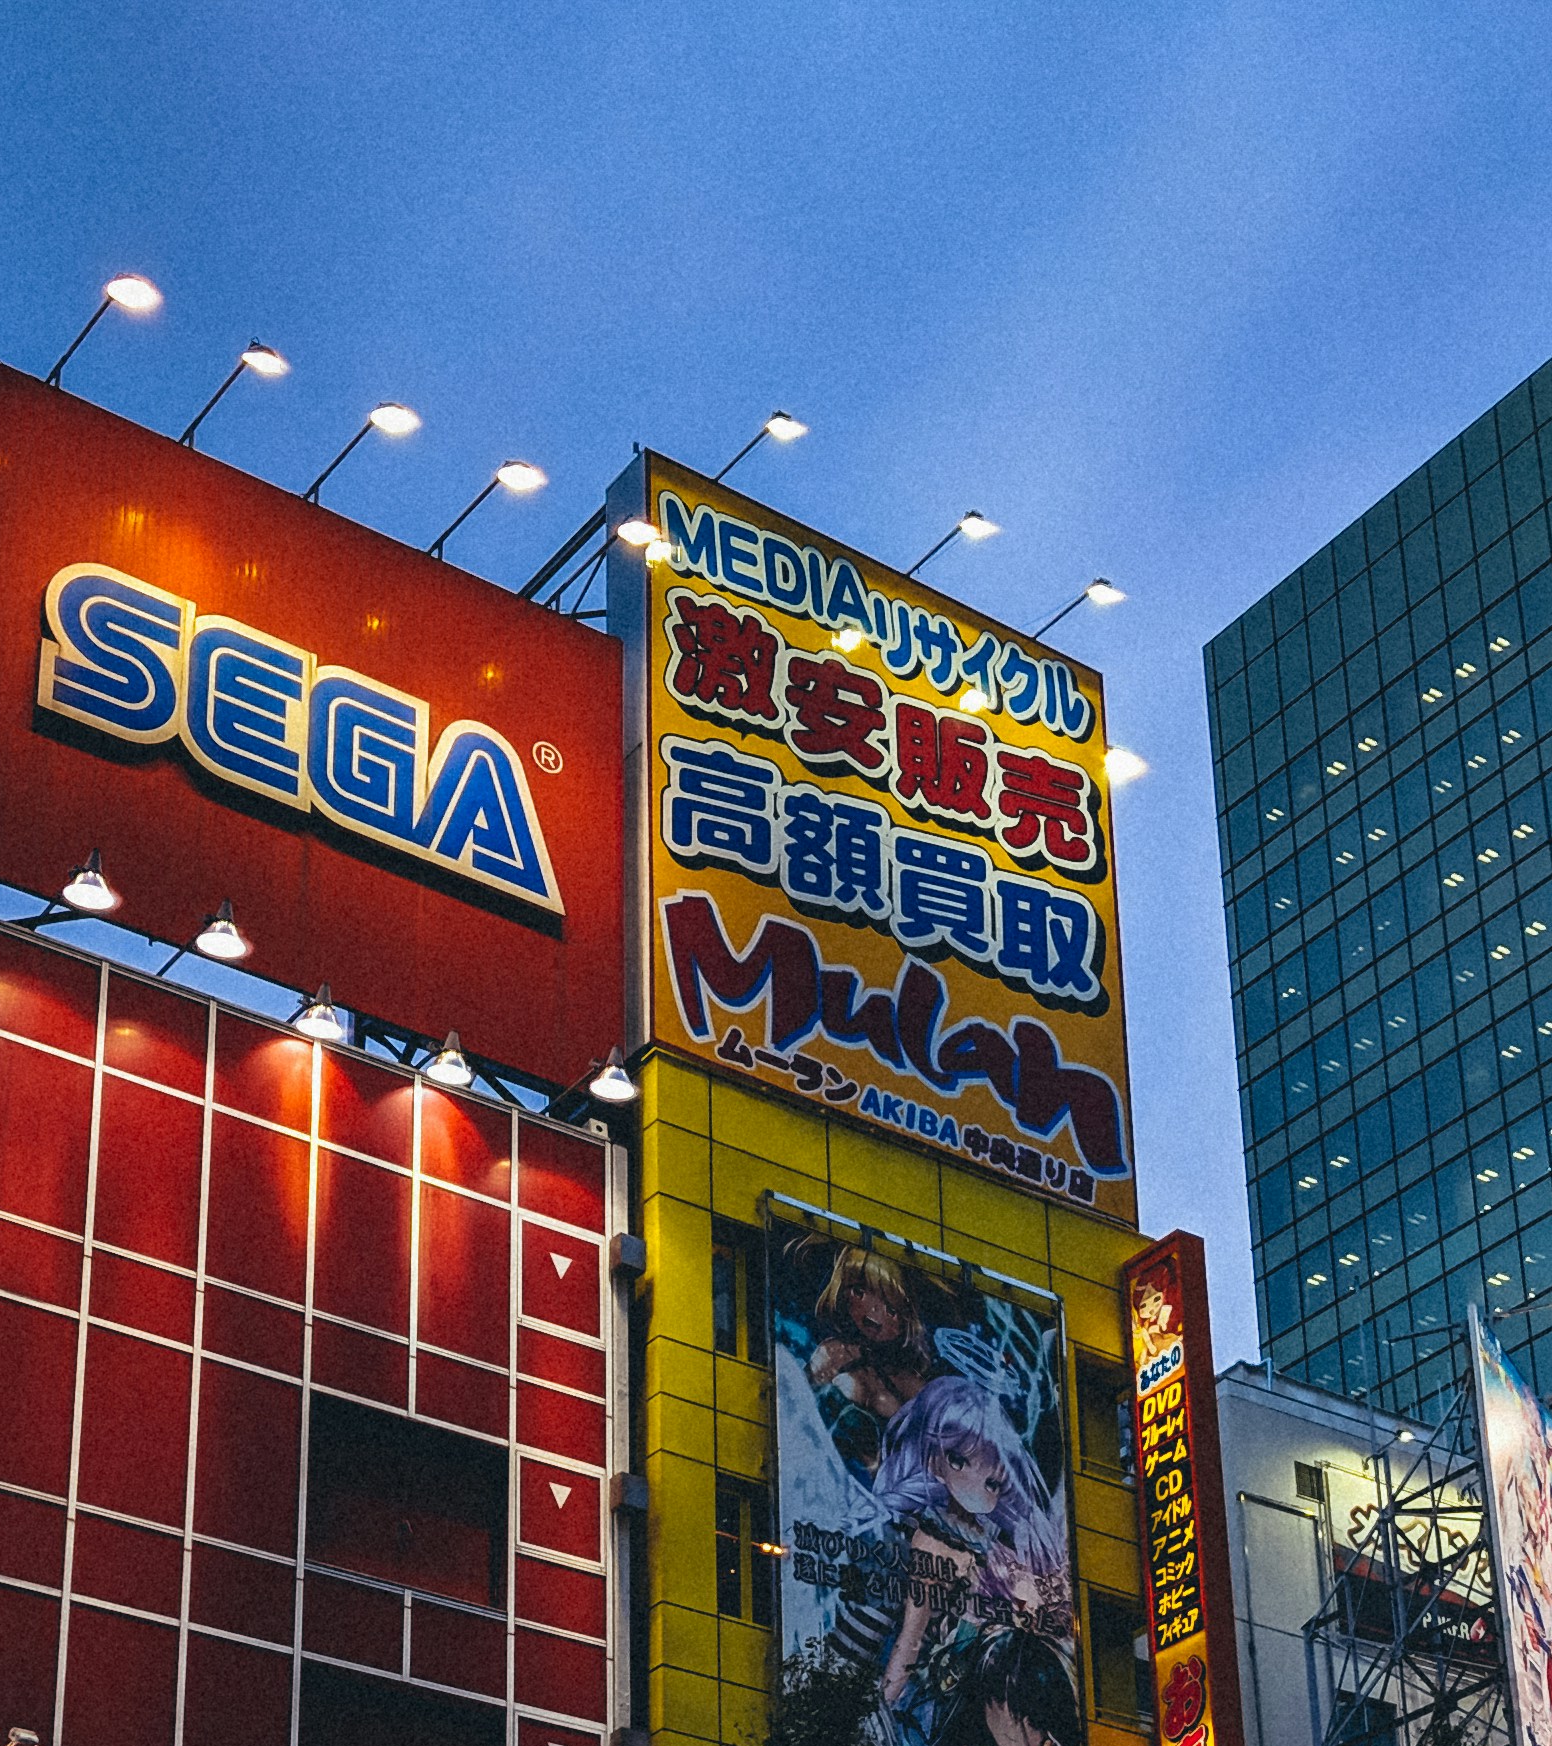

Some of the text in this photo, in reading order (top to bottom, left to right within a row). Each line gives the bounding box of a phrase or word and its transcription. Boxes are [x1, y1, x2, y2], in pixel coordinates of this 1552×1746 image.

[37, 562, 566, 916] SEGA
[665, 588, 1097, 868] 激安販売
[661, 737, 1099, 999] 高額買取
[660, 890, 1132, 1179] Mulan
[860, 1087, 959, 1148] AKIBA
[1139, 1345, 1181, 1385] あなたの
[1142, 1382, 1182, 1424] DVD
[1145, 1439, 1188, 1478] ゲーム
[1155, 1469, 1183, 1502] CD
[1151, 1498, 1193, 1533] アイドル
[1153, 1519, 1196, 1562] アニメ
[1155, 1551, 1194, 1588] コミック
[1158, 1584, 1196, 1616] ホビー
[1157, 1607, 1199, 1647] フィギュア
